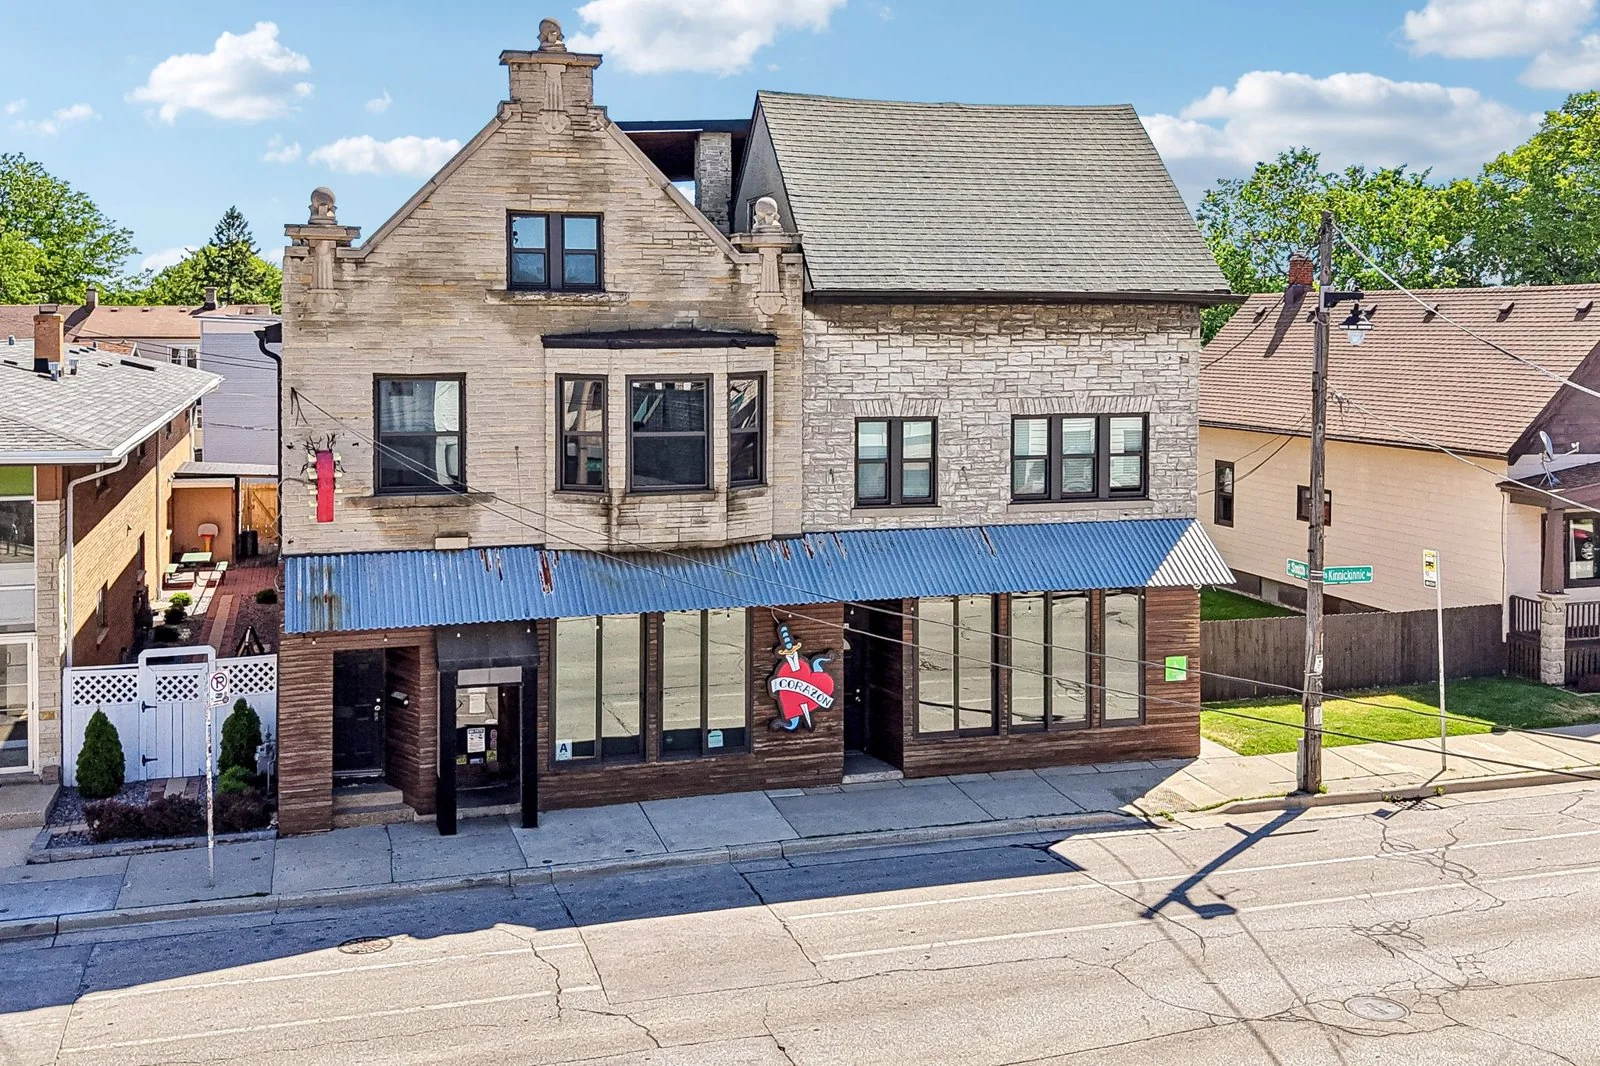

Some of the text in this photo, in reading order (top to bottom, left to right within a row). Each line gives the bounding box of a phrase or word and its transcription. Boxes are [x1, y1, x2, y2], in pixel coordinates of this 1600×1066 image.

[1291, 562, 1306, 576] Smith
[1328, 569, 1366, 581] Kinnickinnic
[779, 678, 832, 707] CORAZON
[559, 743, 568, 753] A
